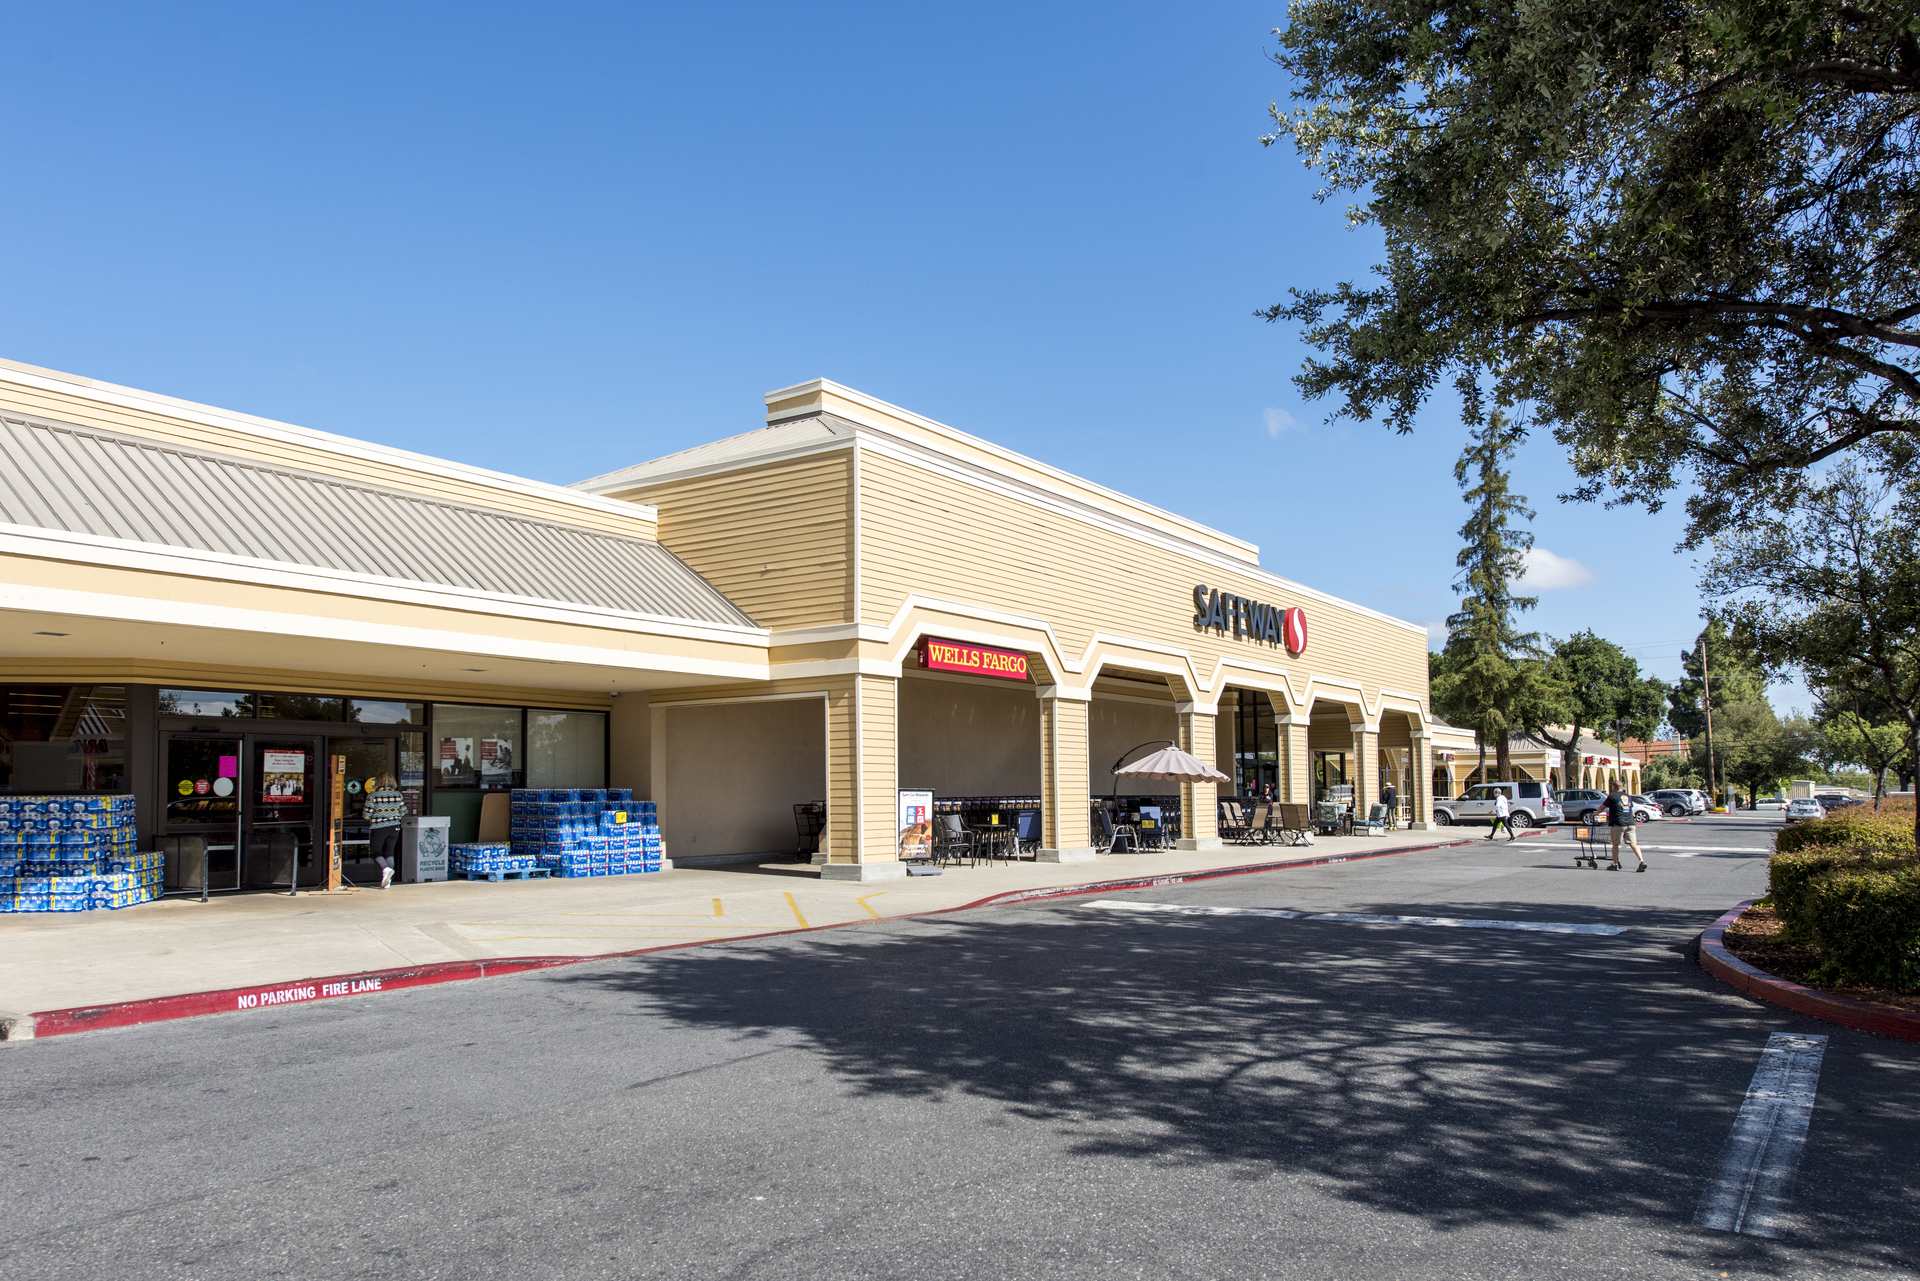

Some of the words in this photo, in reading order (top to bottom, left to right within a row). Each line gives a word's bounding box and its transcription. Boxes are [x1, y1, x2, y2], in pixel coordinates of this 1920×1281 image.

[1193, 584, 1286, 644] SAFEWAY
[928, 643, 980, 667] WELLS
[982, 652, 1027, 673] FARGO
[238, 994, 257, 1009] NO
[260, 986, 316, 1006] PARKING
[322, 981, 349, 997] FIRE
[351, 978, 382, 993] LANE
